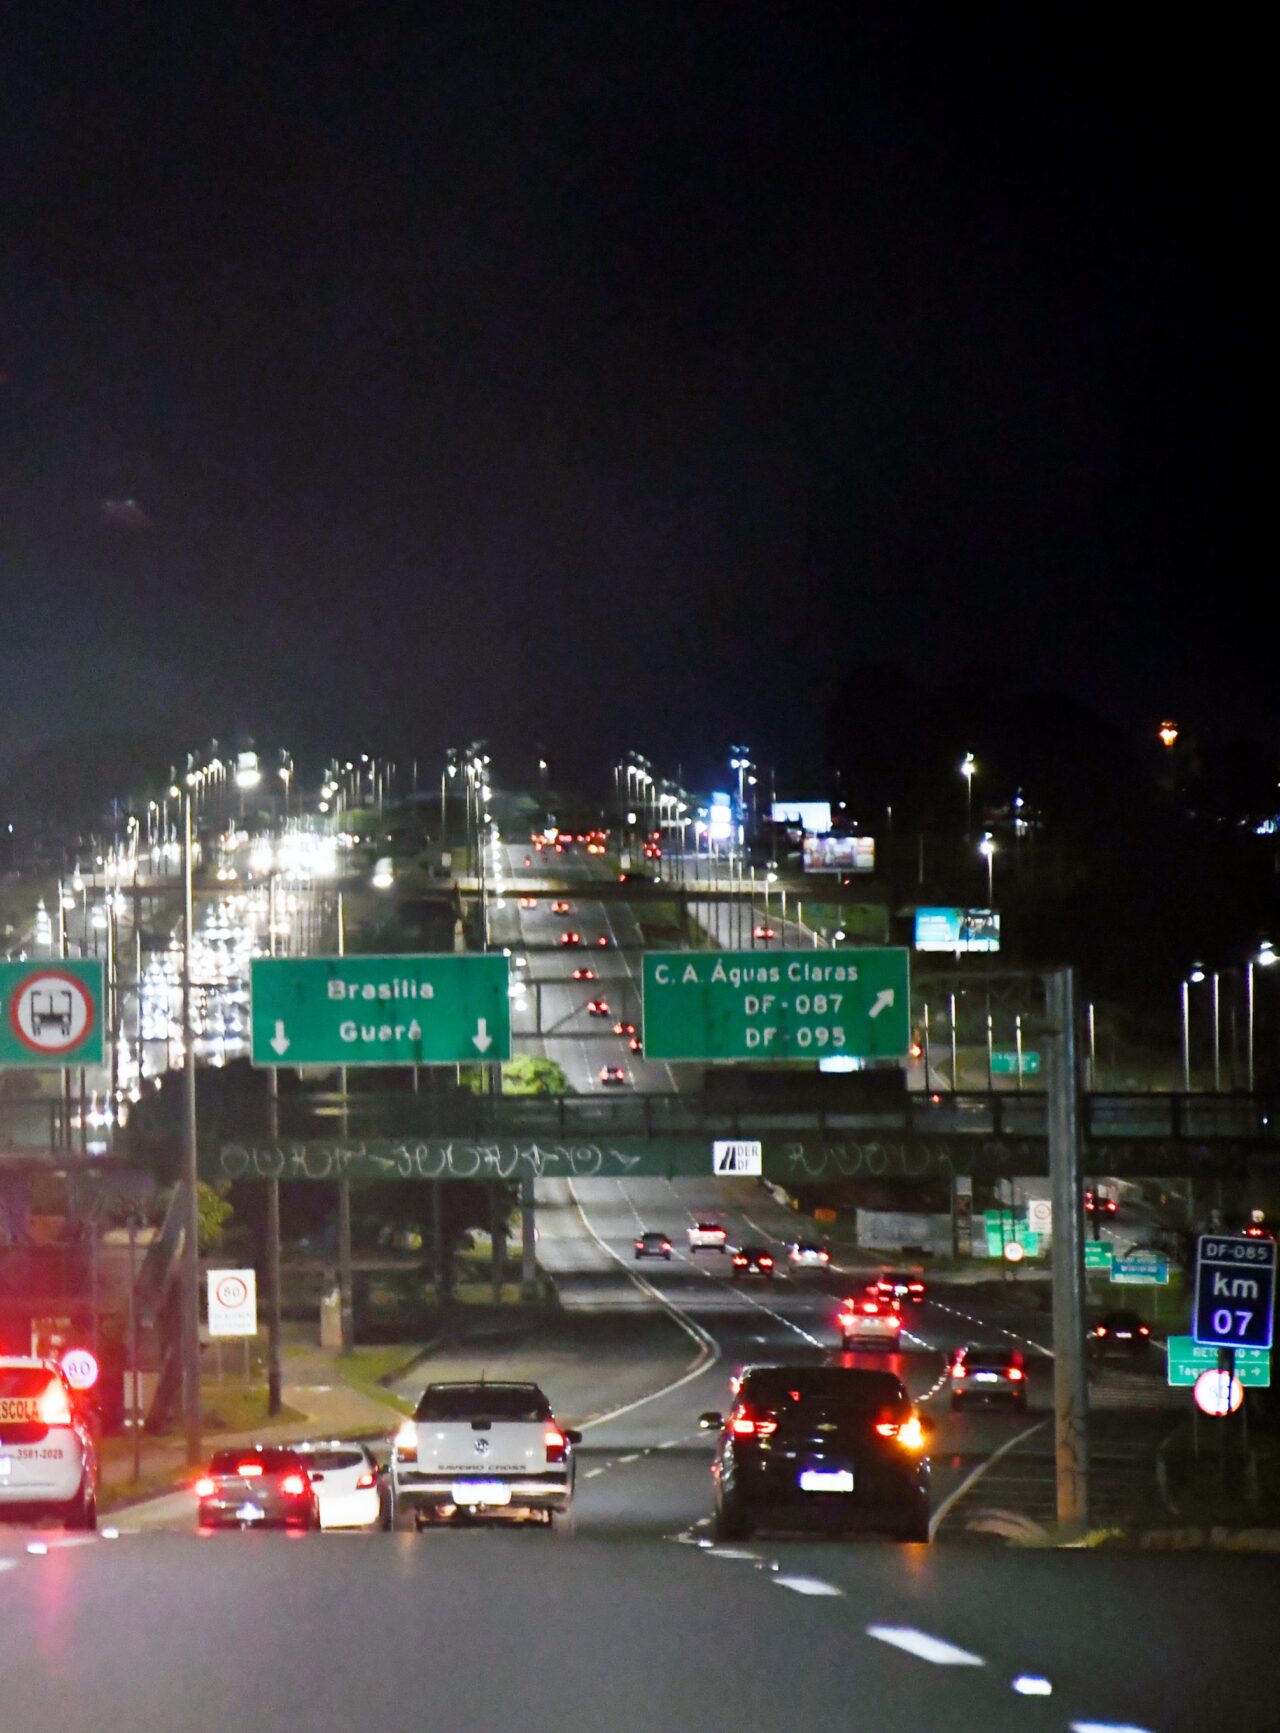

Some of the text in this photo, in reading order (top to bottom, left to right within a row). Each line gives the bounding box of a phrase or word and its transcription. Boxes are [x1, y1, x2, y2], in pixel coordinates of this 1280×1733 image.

[711, 959, 780, 988] Águas
[787, 962, 858, 983] Claras
[339, 1019, 422, 1042] Guará
[1206, 1243, 1268, 1261] DF-085
[1213, 1272, 1259, 1300] km
[1213, 1309, 1254, 1336] 07
